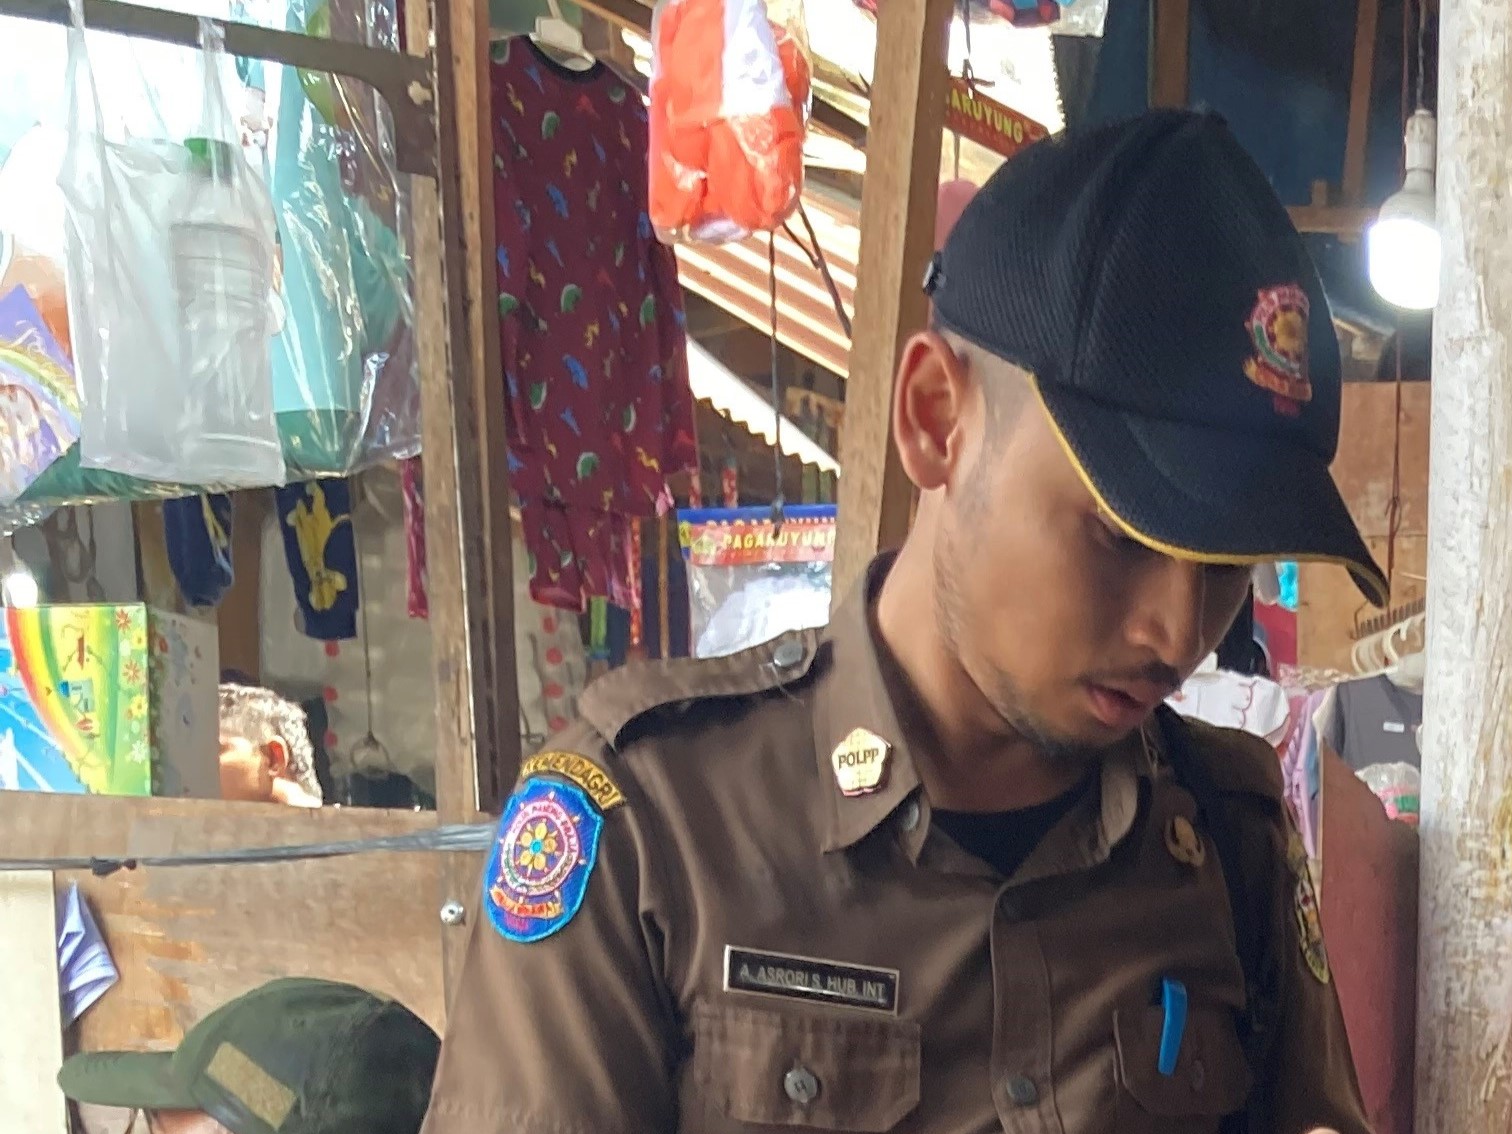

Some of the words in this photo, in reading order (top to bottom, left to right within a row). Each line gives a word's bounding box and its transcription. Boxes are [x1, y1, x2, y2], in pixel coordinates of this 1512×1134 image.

[946, 87, 1024, 144] ARUYUNG
[838, 747, 879, 769] POLPP
[757, 966, 809, 987] ASRORI
